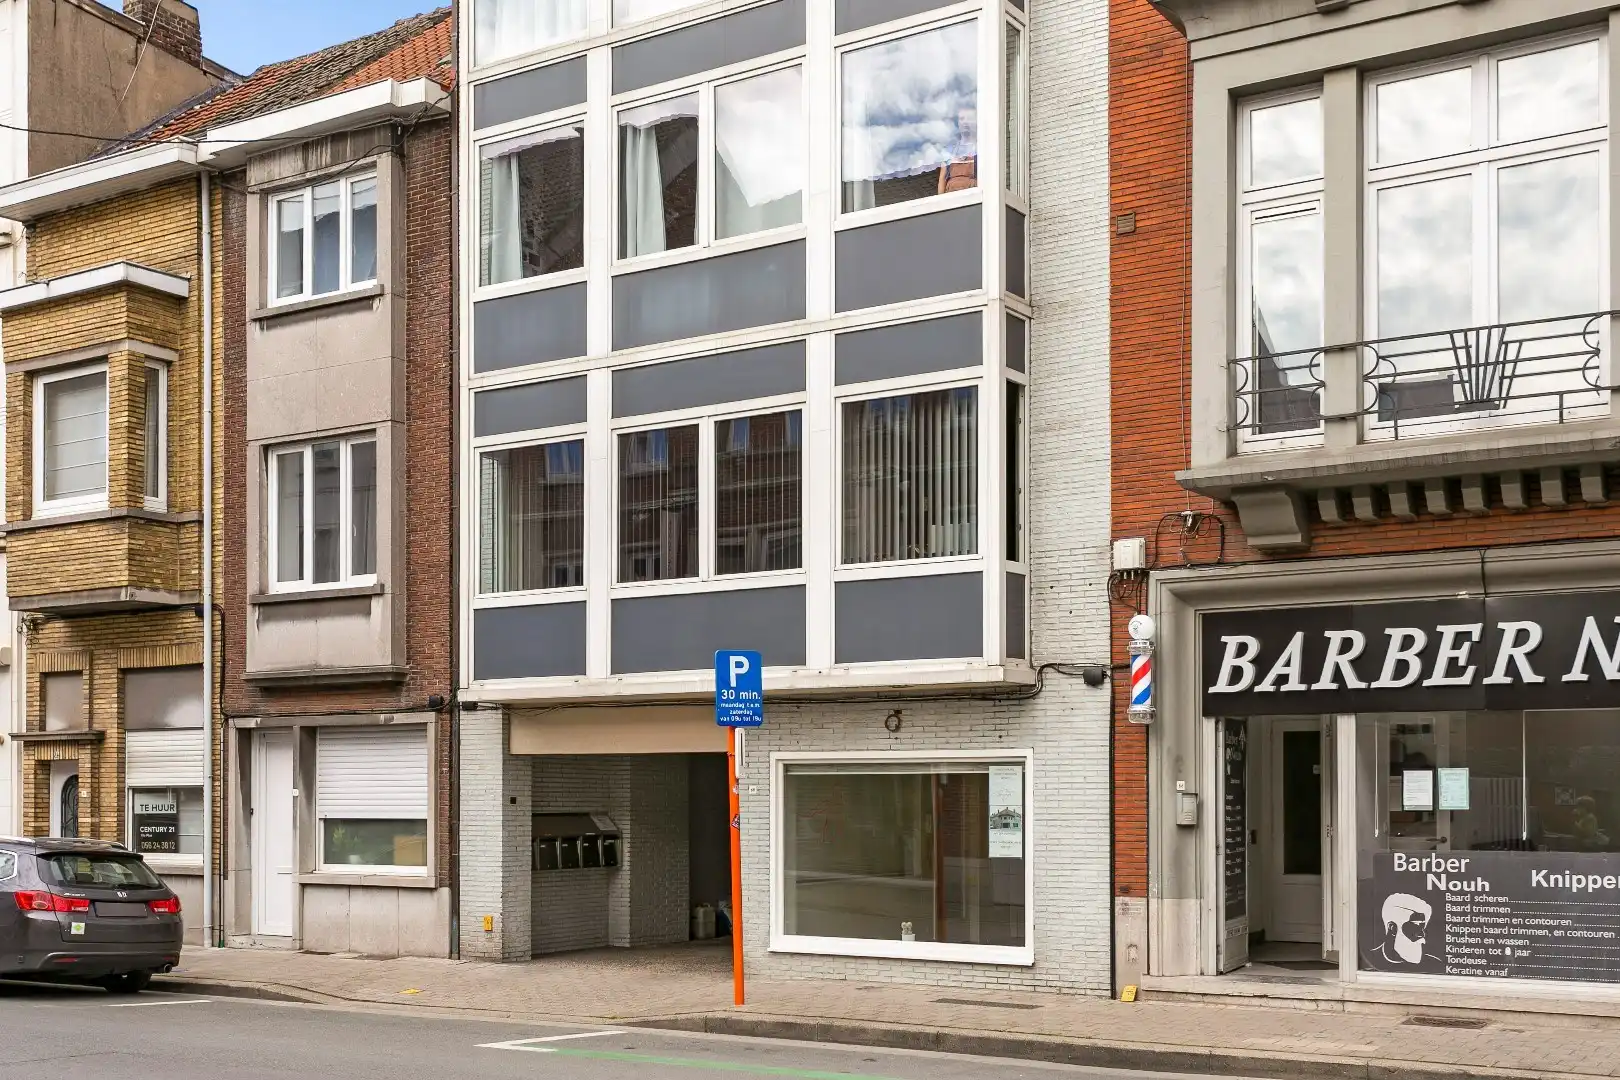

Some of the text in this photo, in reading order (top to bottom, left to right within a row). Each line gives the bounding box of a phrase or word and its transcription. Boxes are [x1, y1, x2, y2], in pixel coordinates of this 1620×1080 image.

[1207, 620, 1546, 694] BARBER
[729, 655, 750, 688] P
[721, 690, 761, 699] 30 min.
[1393, 852, 1470, 873] Barber
[1426, 873, 1490, 892] Nouh
[1531, 869, 1620, 892] Knippe
[1445, 893, 1508, 902] Baard scheren
[1445, 903, 1510, 913] Baard trimmen
[1445, 914, 1470, 922] Baard
[1472, 915, 1509, 924] trimmen
[1525, 918, 1572, 926] contouren
[1445, 924, 1481, 934] Knippen
[1483, 926, 1508, 934] baard
[1510, 927, 1551, 937] trimmen,
[1567, 930, 1615, 938] contouren
[1445, 934, 1481, 943] Brushen
[1445, 945, 1485, 954] Kinderen
[1514, 948, 1531, 958] jaar
[1445, 955, 1487, 965] Tondeuse
[1445, 966, 1508, 976] Keratine vanaf
